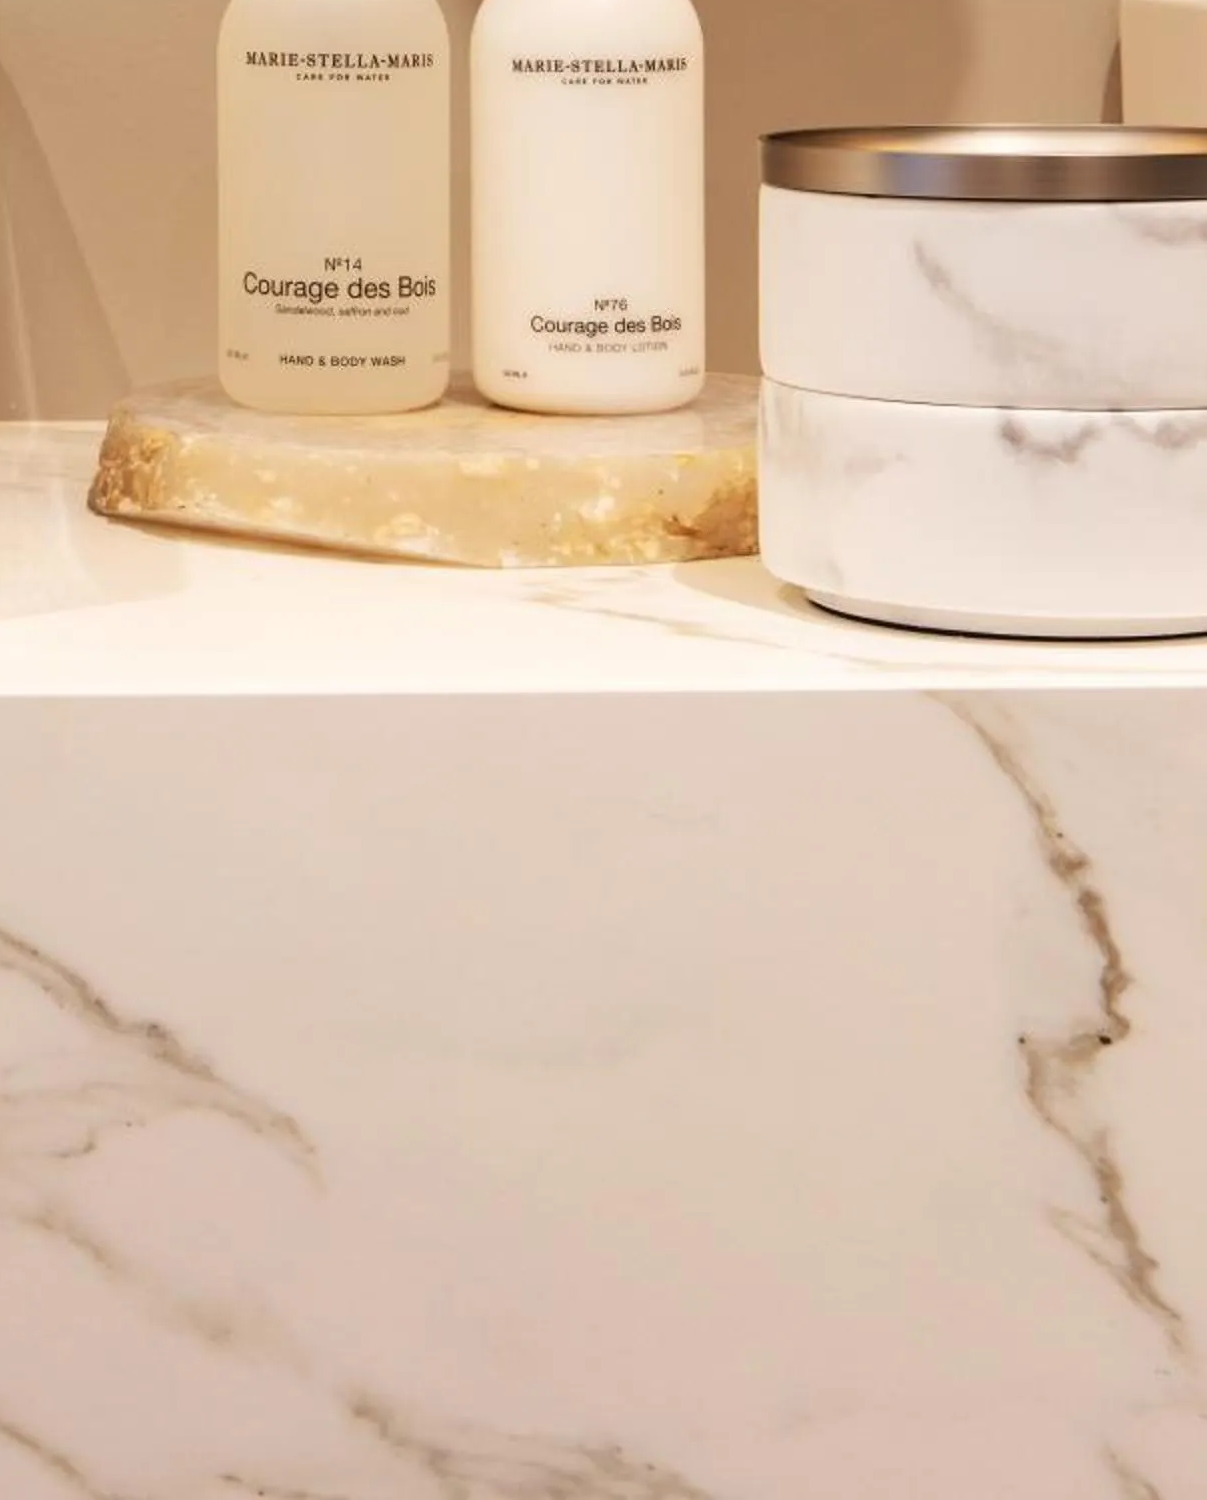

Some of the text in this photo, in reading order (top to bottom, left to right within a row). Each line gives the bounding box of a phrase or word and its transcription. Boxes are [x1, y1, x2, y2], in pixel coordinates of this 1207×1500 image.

[246, 51, 434, 69] MARIE-STELLA-MARIS
[512, 57, 687, 73] MARIE-STELLA-MARIS
[296, 73, 391, 81] CARE FOR WATER
[561, 77, 648, 85] CARE FOR WATER
[243, 271, 436, 304] Courage des Bois
[531, 315, 681, 337] Courage des Bois
[548, 343, 582, 353] HAND
[596, 343, 627, 353] BODY
[279, 355, 406, 367] HAND & BODY WASH
